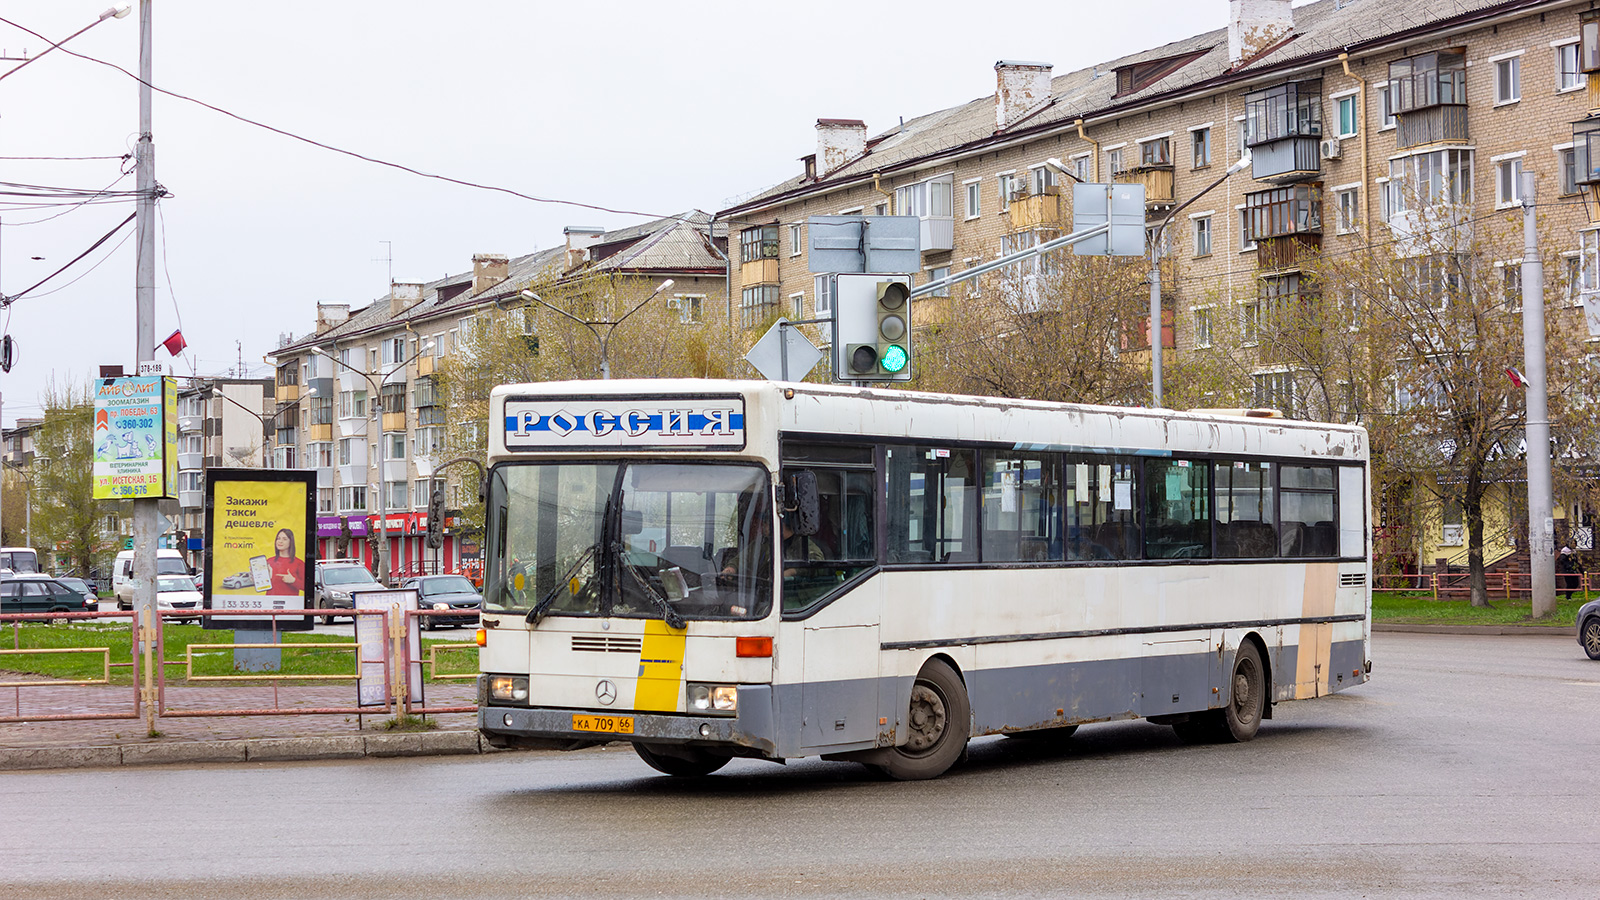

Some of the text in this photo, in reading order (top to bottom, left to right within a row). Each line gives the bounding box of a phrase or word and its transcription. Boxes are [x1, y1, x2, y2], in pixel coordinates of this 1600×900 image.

[107, 397, 150, 406] ЗООМАГАЗИН
[149, 406, 158, 415] 63
[122, 418, 153, 429] 360-302
[514, 408, 734, 437] РОССИЯ
[109, 461, 148, 469] ВЕТЕРИНАРНАЯ
[119, 485, 148, 495] 360-576
[225, 495, 268, 506] Закажи
[225, 509, 257, 517] такси
[594, 717, 614, 731] 709
[619, 718, 630, 728] 66
